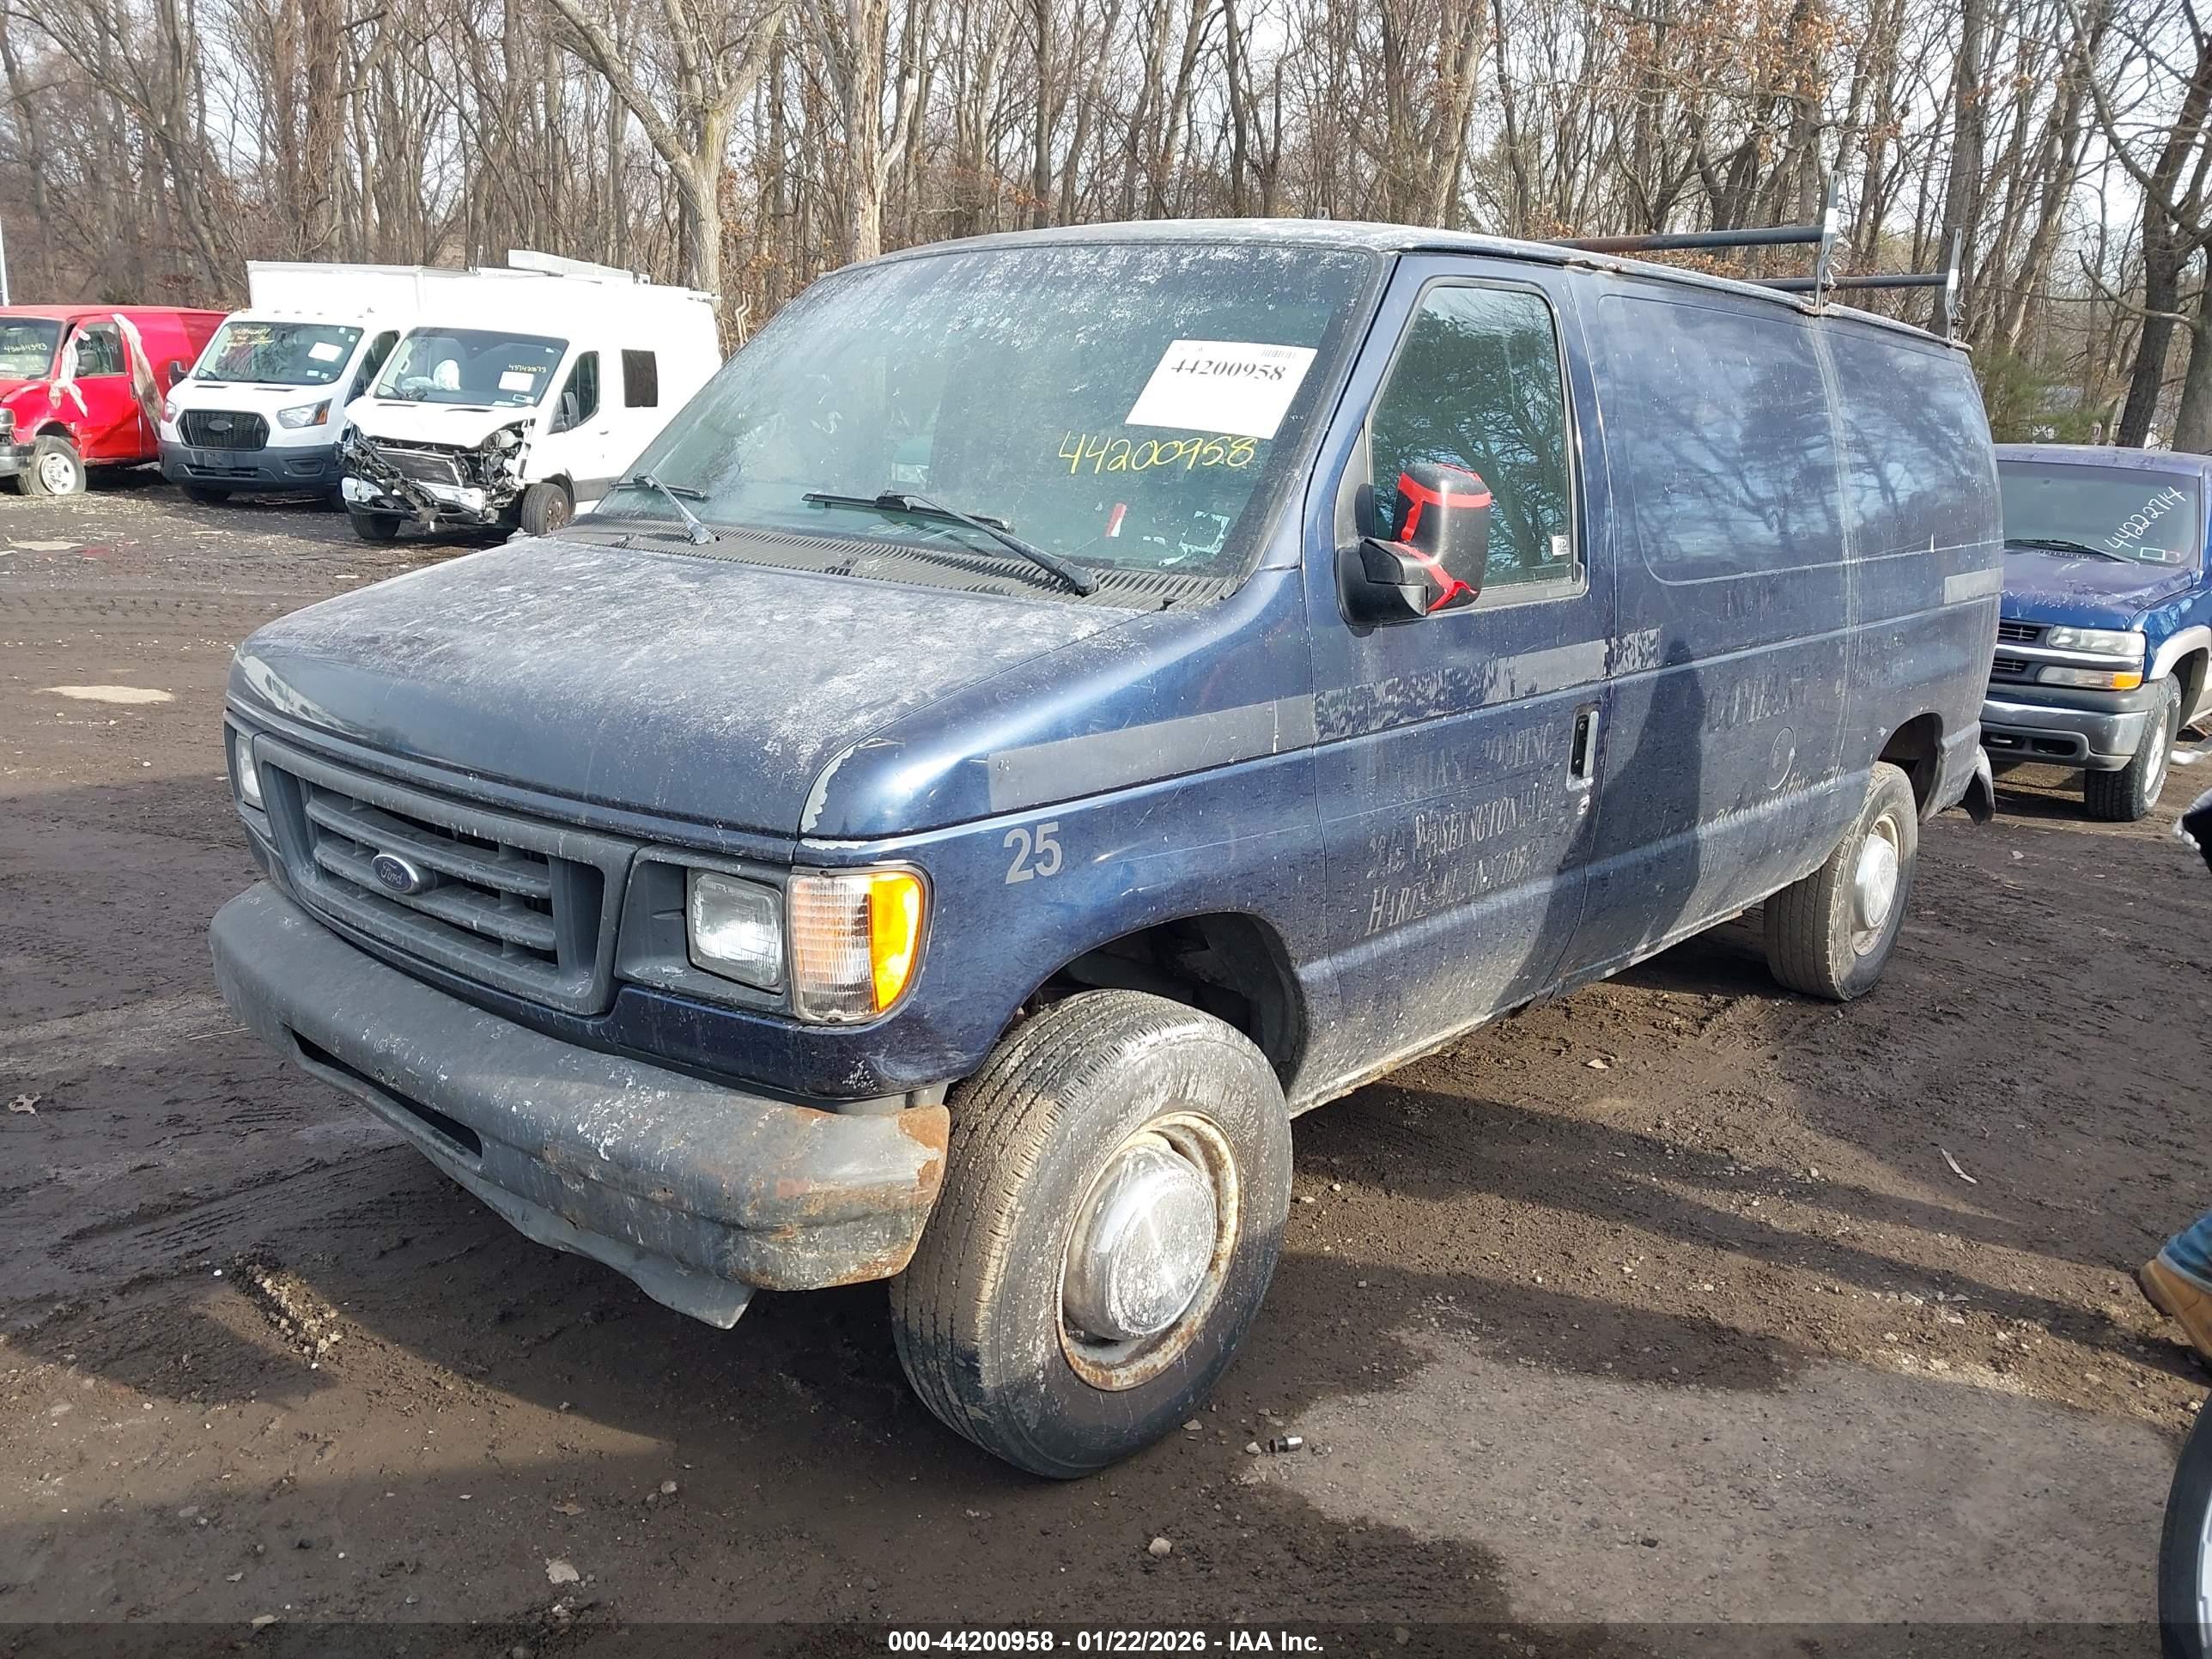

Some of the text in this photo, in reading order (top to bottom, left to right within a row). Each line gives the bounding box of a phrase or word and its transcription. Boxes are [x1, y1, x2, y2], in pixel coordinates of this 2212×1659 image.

[1171, 358, 1286, 381] 44200958
[1058, 430, 1259, 474] 44200958
[2104, 486, 2186, 549] 44222714
[380, 860, 404, 885] Ford
[1003, 821, 1062, 884] 25
